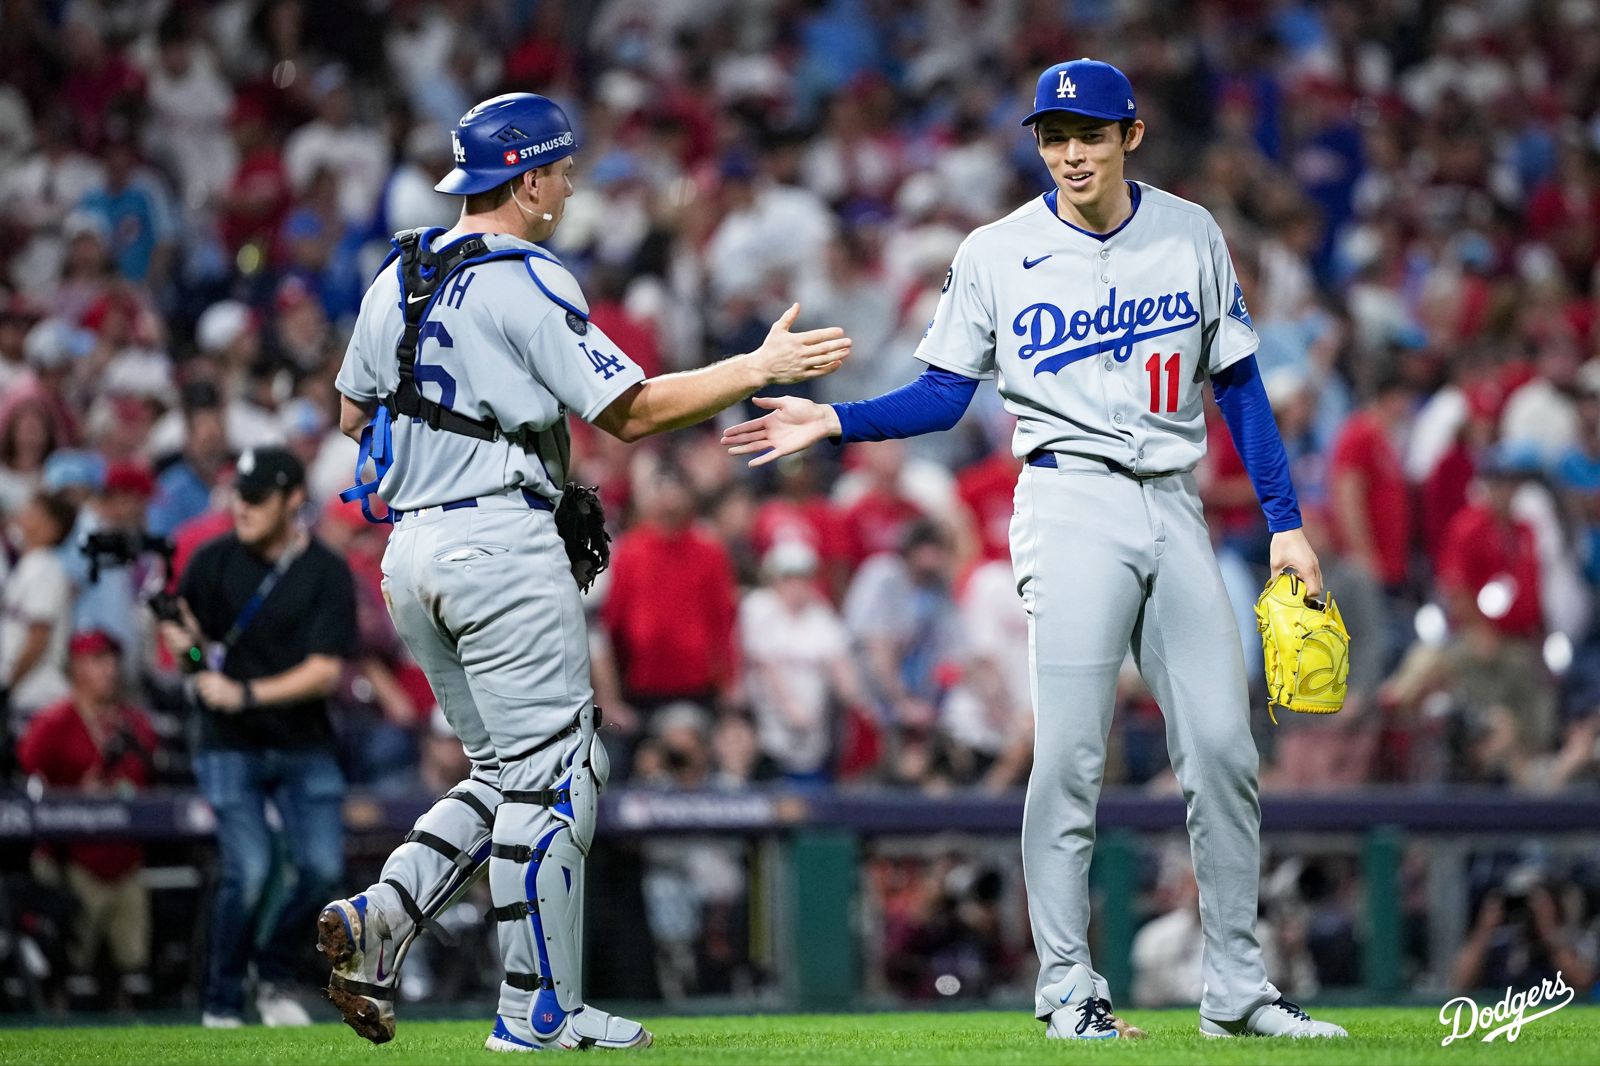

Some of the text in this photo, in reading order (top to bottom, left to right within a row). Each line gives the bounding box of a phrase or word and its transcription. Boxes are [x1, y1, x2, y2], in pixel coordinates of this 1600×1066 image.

[1056, 70, 1077, 98] LA
[519, 137, 564, 159] STRAUSS
[1012, 286, 1200, 378] Dodgers
[578, 342, 626, 380] LA
[1145, 352, 1181, 413] 11
